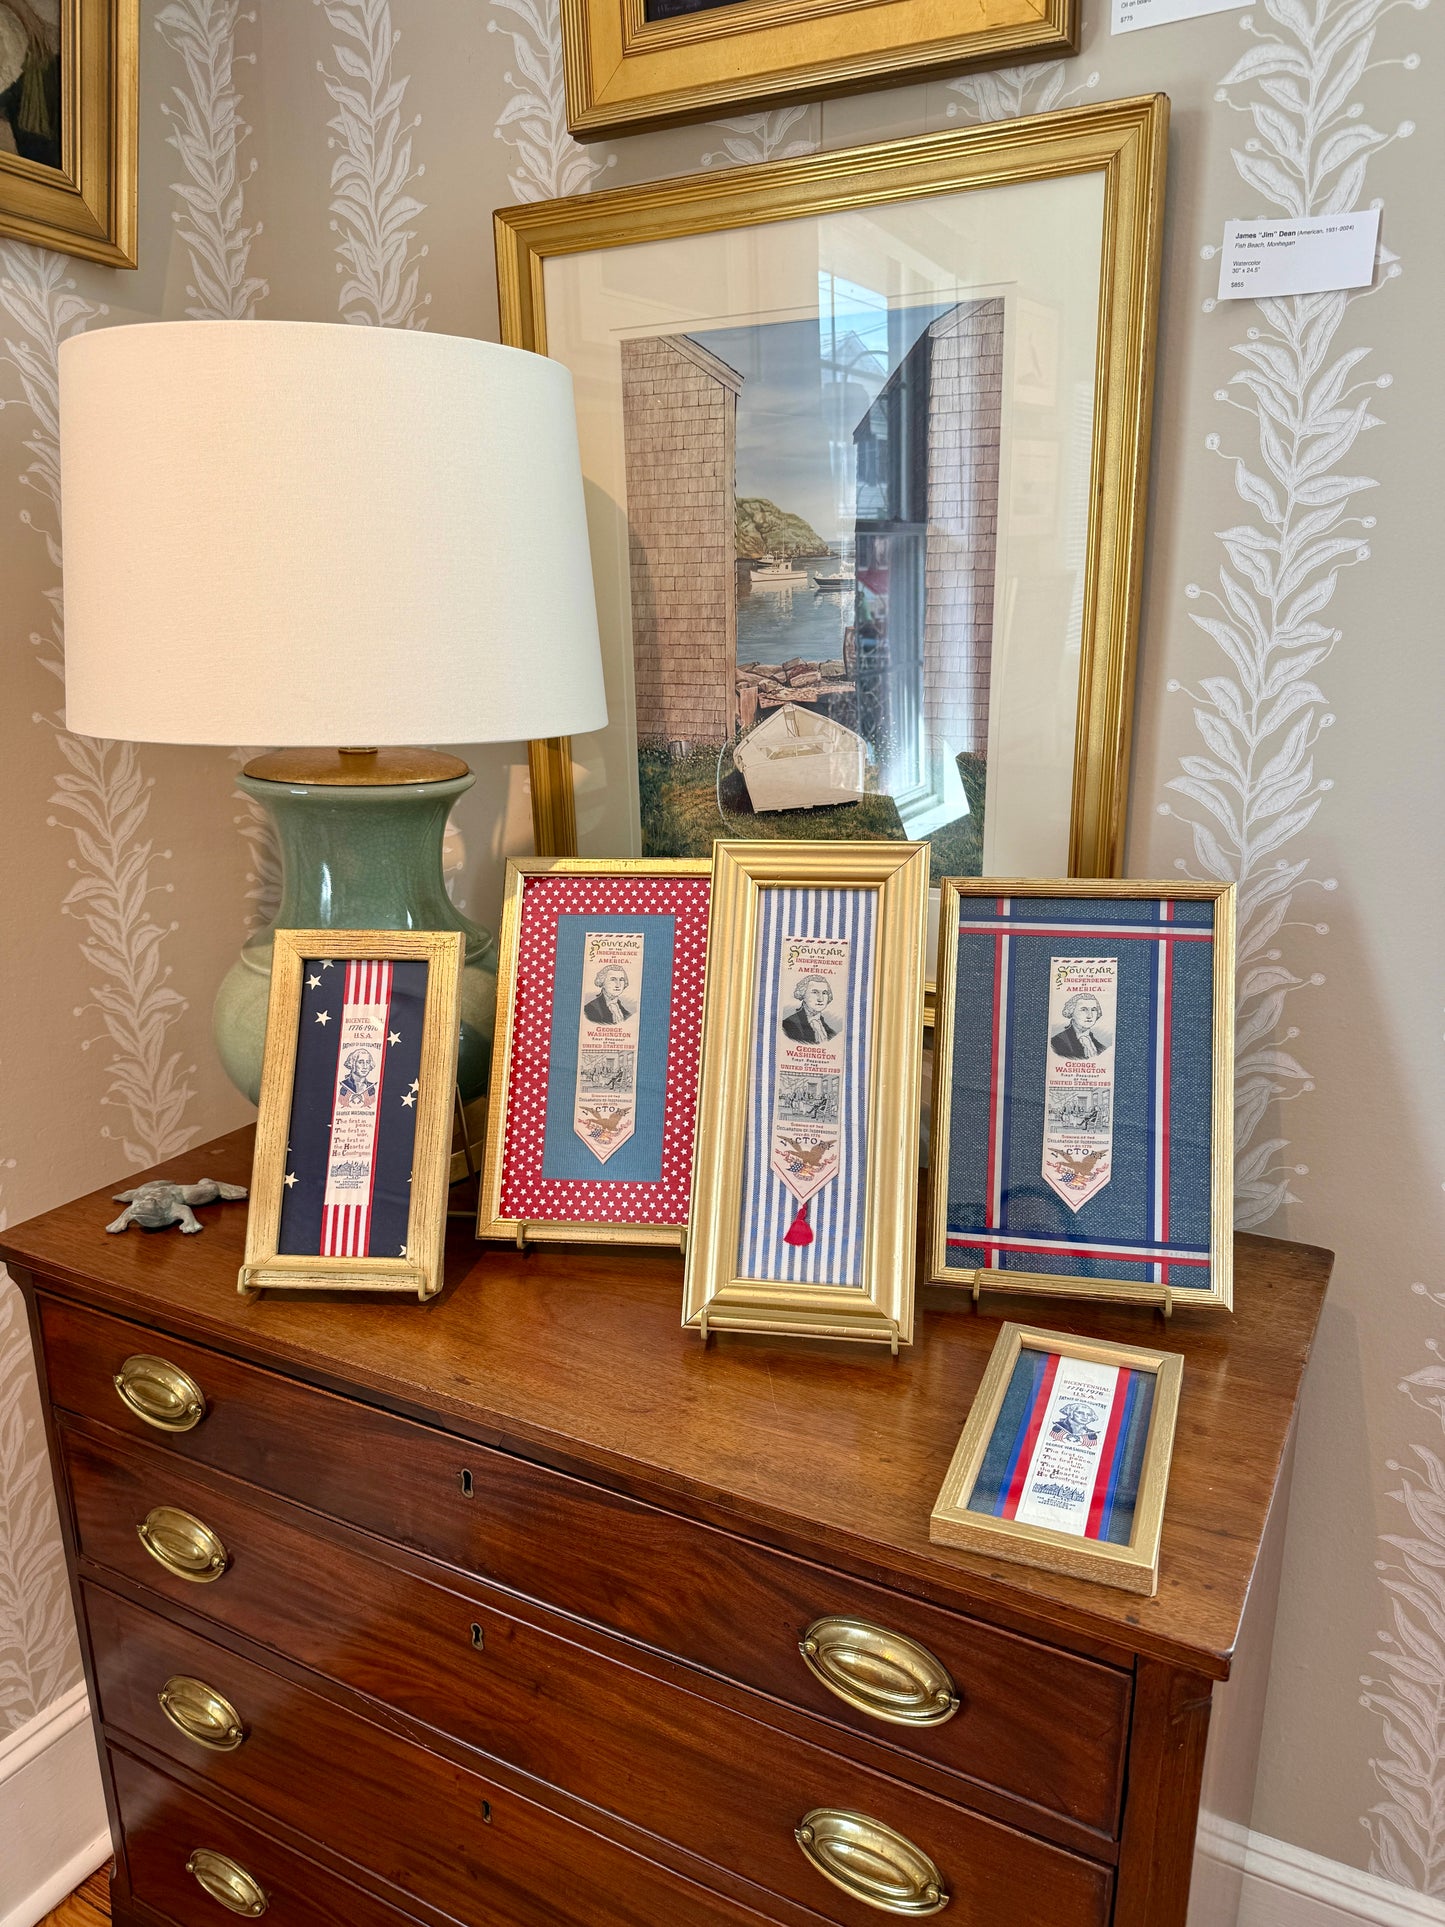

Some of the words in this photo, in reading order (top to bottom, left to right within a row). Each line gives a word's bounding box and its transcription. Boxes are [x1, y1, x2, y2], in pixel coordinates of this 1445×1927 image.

[590, 940, 640, 951] SOUVENIR
[790, 945, 845, 957] SOUVENIR
[795, 958, 843, 966] INDEPENDENCE
[798, 967, 836, 975] AMERICA.
[1058, 966, 1115, 977] SOUVENIR
[796, 1045, 827, 1054] GEORGE
[786, 1050, 836, 1060] WASHINGTON
[1052, 1469, 1078, 1478] Hearts
